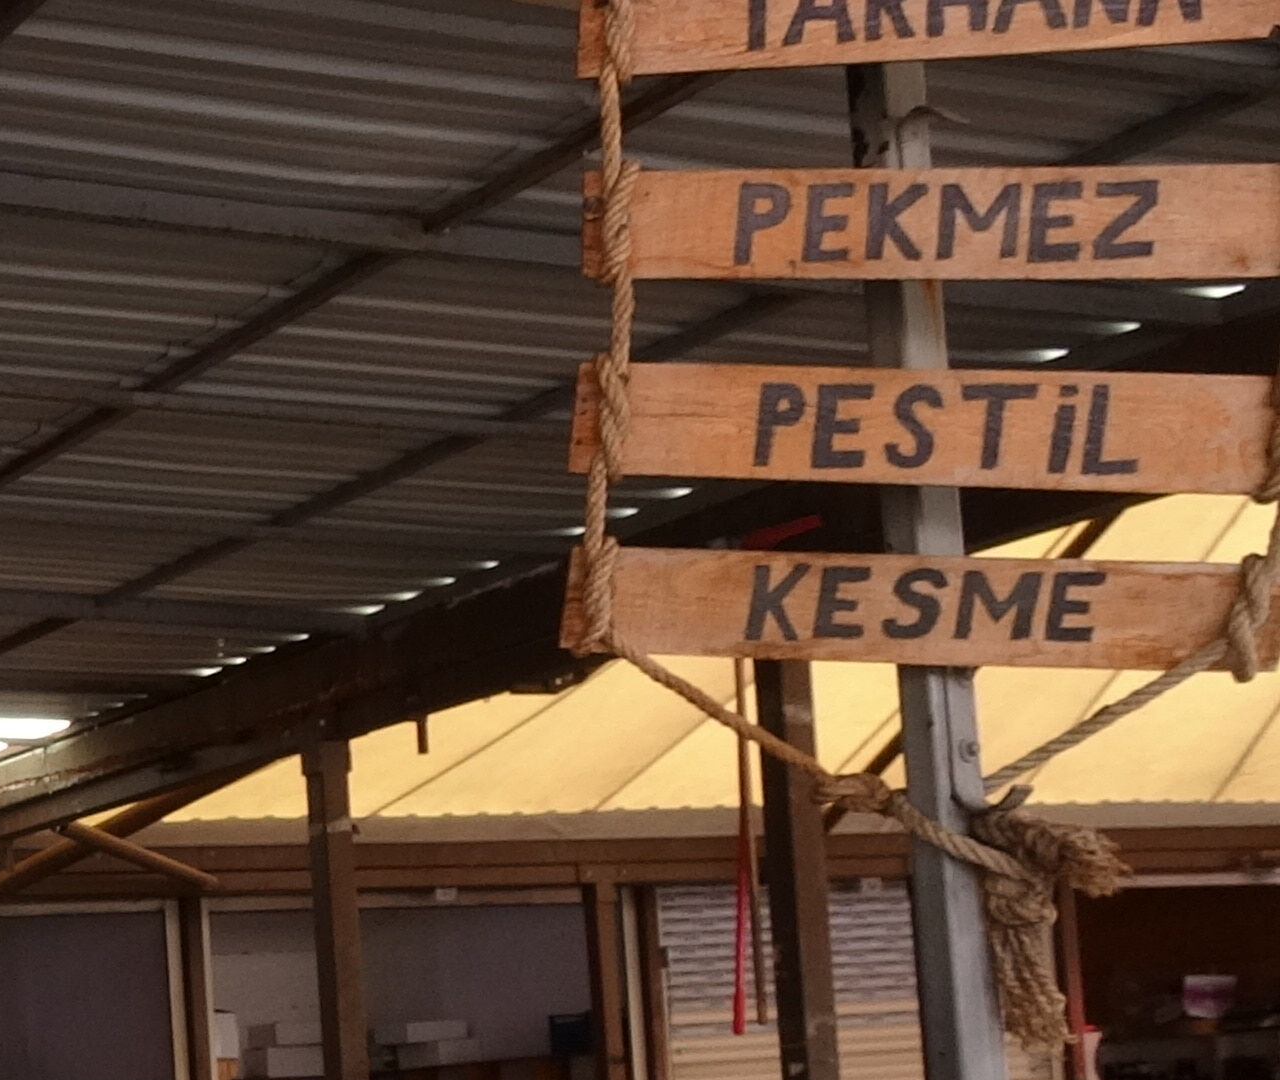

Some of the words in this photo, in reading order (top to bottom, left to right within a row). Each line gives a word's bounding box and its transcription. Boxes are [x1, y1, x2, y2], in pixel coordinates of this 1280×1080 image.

[732, 179, 1160, 266] PEKMEZ
[751, 382, 1139, 477] PESTİL
[743, 563, 1107, 643] KESME
